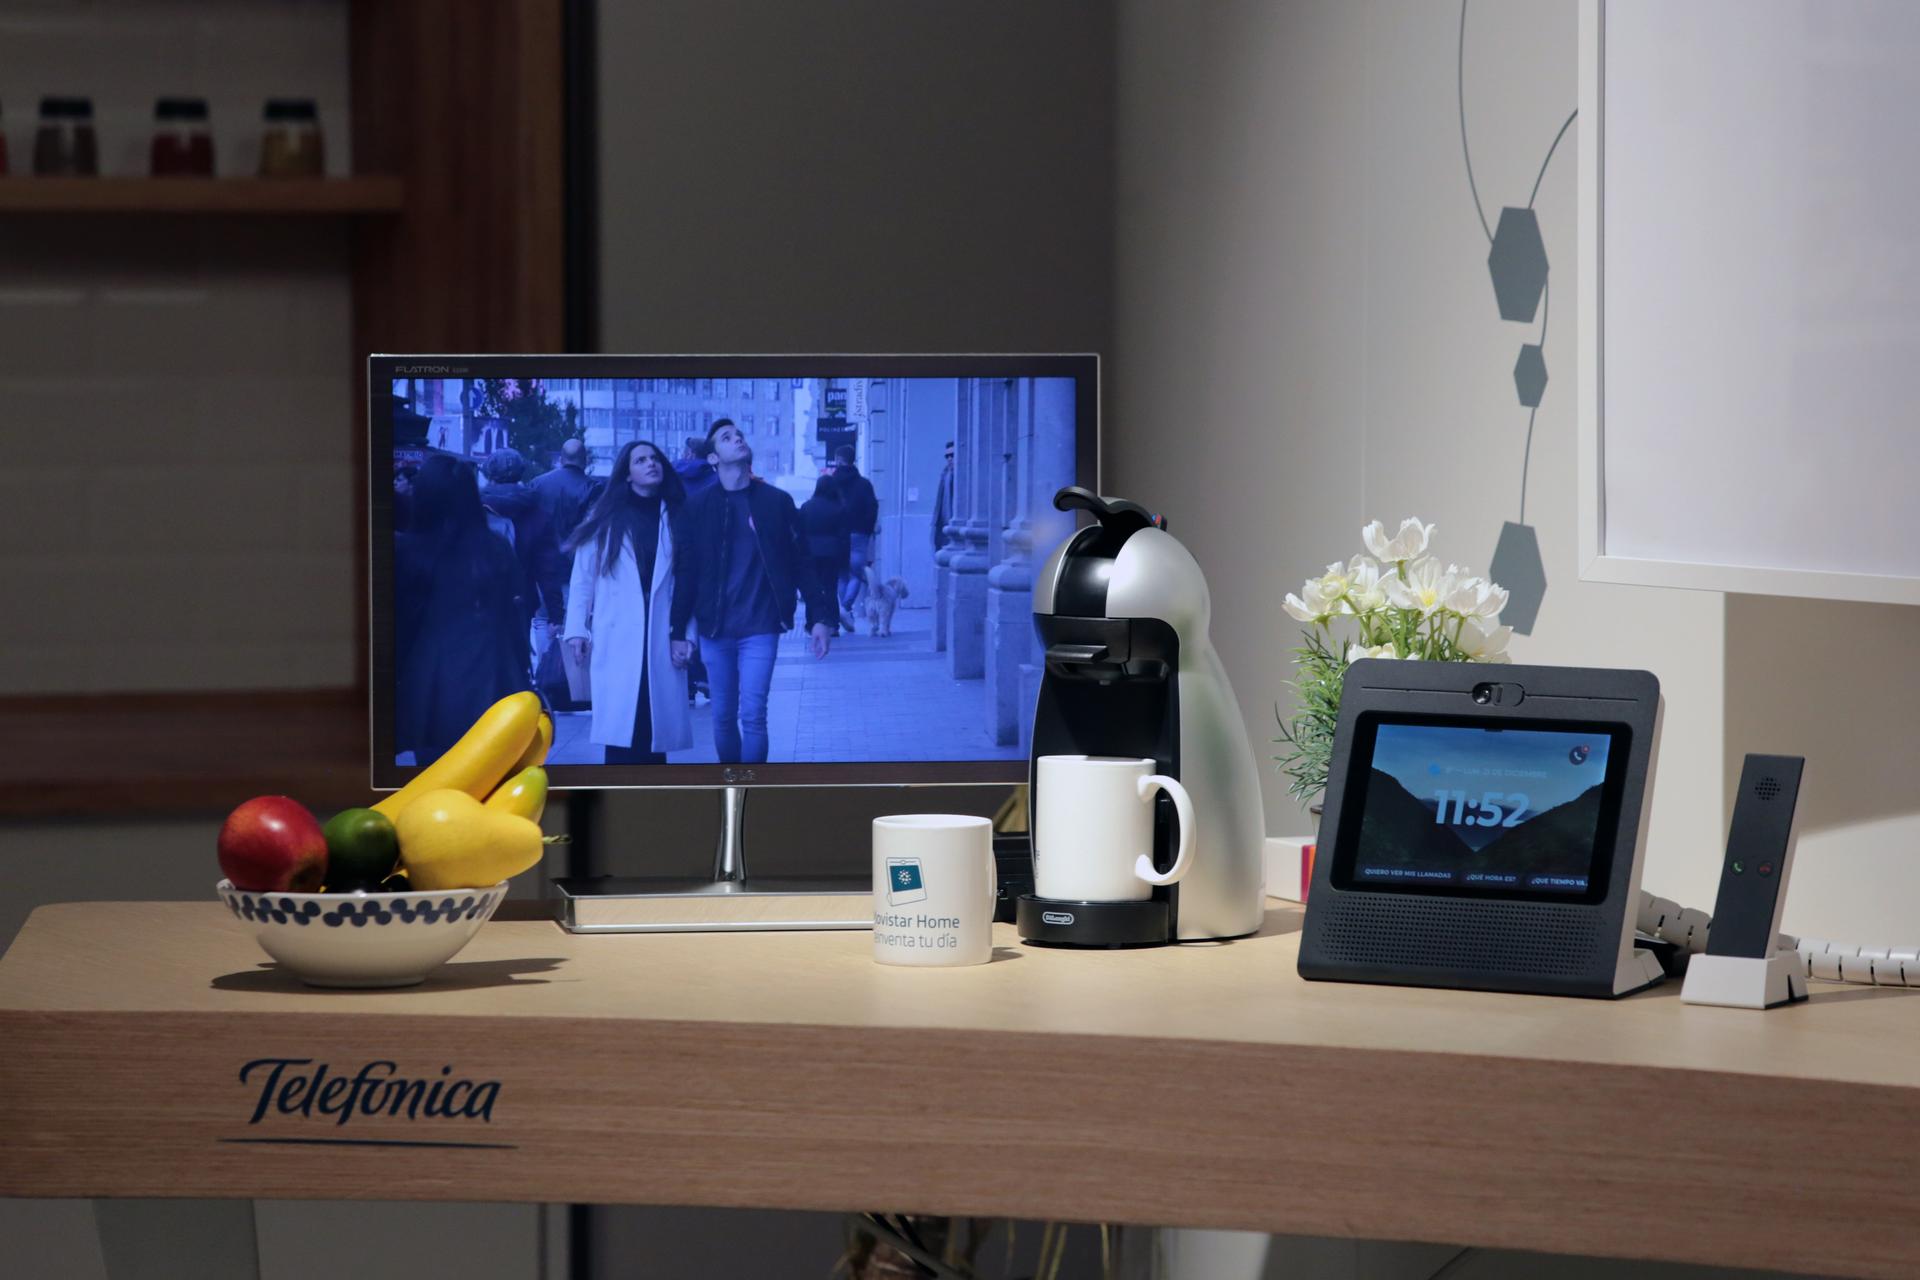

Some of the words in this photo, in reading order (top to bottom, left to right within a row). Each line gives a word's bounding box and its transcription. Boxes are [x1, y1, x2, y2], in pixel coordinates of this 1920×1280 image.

[1434, 790, 1530, 827] 11:52
[1364, 868, 1389, 876] QUIERO
[1417, 871, 1452, 879] LLAMADAS
[1550, 877, 1575, 886] TIEMPO
[916, 914, 960, 929] Home
[918, 935, 934, 948] tu
[937, 932, 958, 948] día
